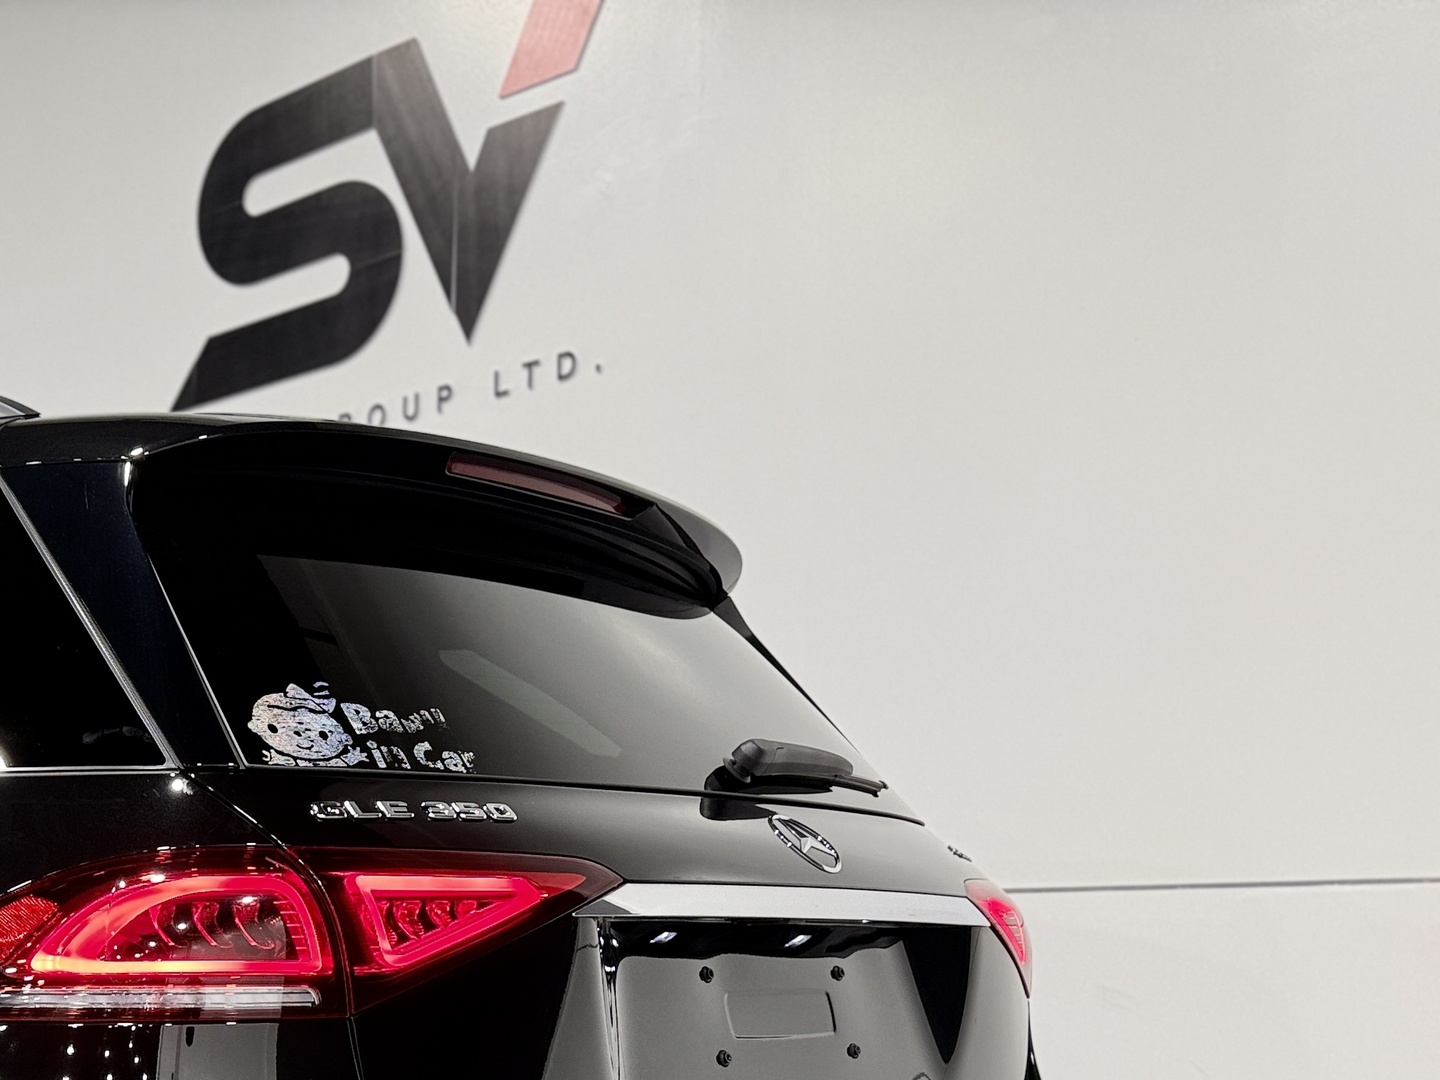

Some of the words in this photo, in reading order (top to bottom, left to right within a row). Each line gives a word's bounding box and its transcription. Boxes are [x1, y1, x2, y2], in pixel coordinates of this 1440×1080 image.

[494, 350, 602, 398] LTD.
[366, 740, 411, 769] in
[413, 741, 477, 774] Car
[310, 800, 415, 821] GLE
[420, 801, 519, 823] 350
